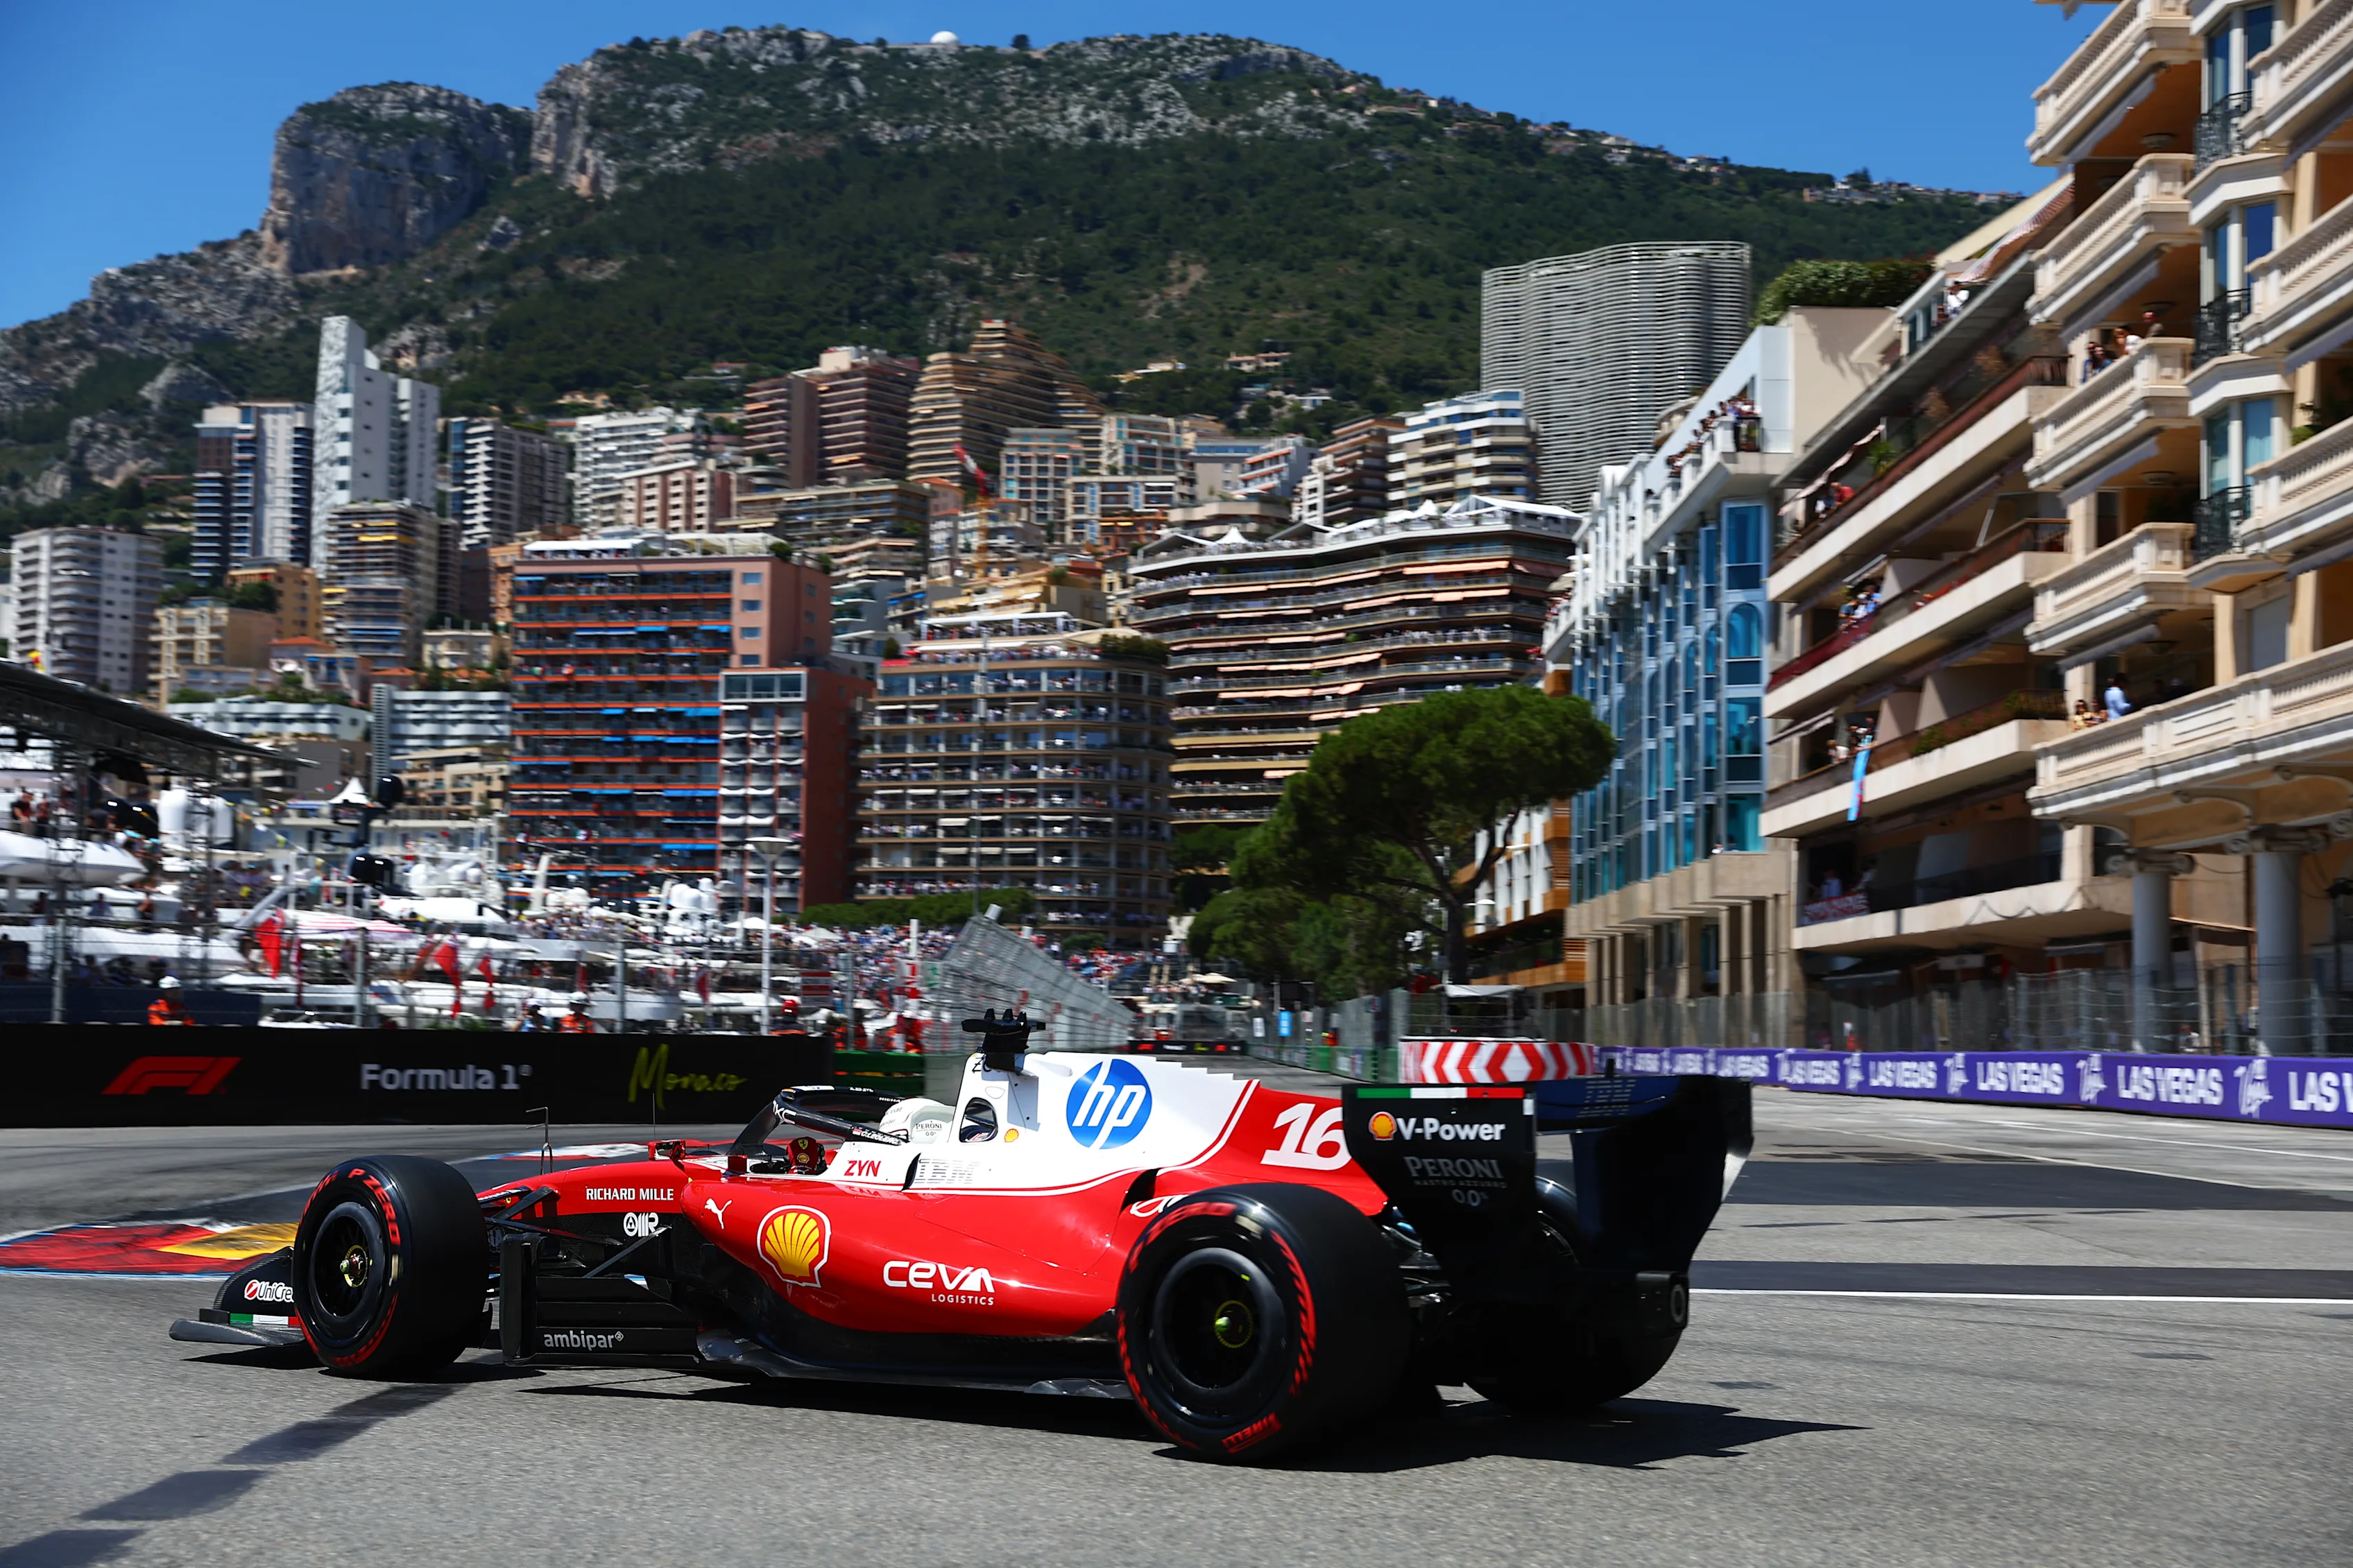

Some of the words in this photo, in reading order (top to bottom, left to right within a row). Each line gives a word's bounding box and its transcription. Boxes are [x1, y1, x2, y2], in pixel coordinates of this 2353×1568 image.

[361, 1064, 495, 1089] Formula
[628, 1044, 748, 1110] Monaco
[1976, 1061, 2010, 1092] LAS
[2008, 1062, 2064, 1096] VEGAS
[2117, 1065, 2156, 1101] LAS
[2154, 1067, 2224, 1106] VEGAS
[1070, 1059, 1147, 1150] hp
[2288, 1071, 2341, 1113] LAS
[1260, 1102, 1353, 1171] 16
[1396, 1117, 1506, 1141] V-Power
[844, 1160, 882, 1177] ZYN
[1403, 1156, 1504, 1179] PERONI
[348, 1168, 366, 1178] P
[361, 1175, 401, 1246] ZERO
[585, 1188, 636, 1200] RICHARD
[639, 1188, 674, 1201] MILLE
[257, 1280, 295, 1303] UniCre
[931, 1293, 995, 1306] LOGISTICS
[543, 1329, 615, 1352] ambipar
